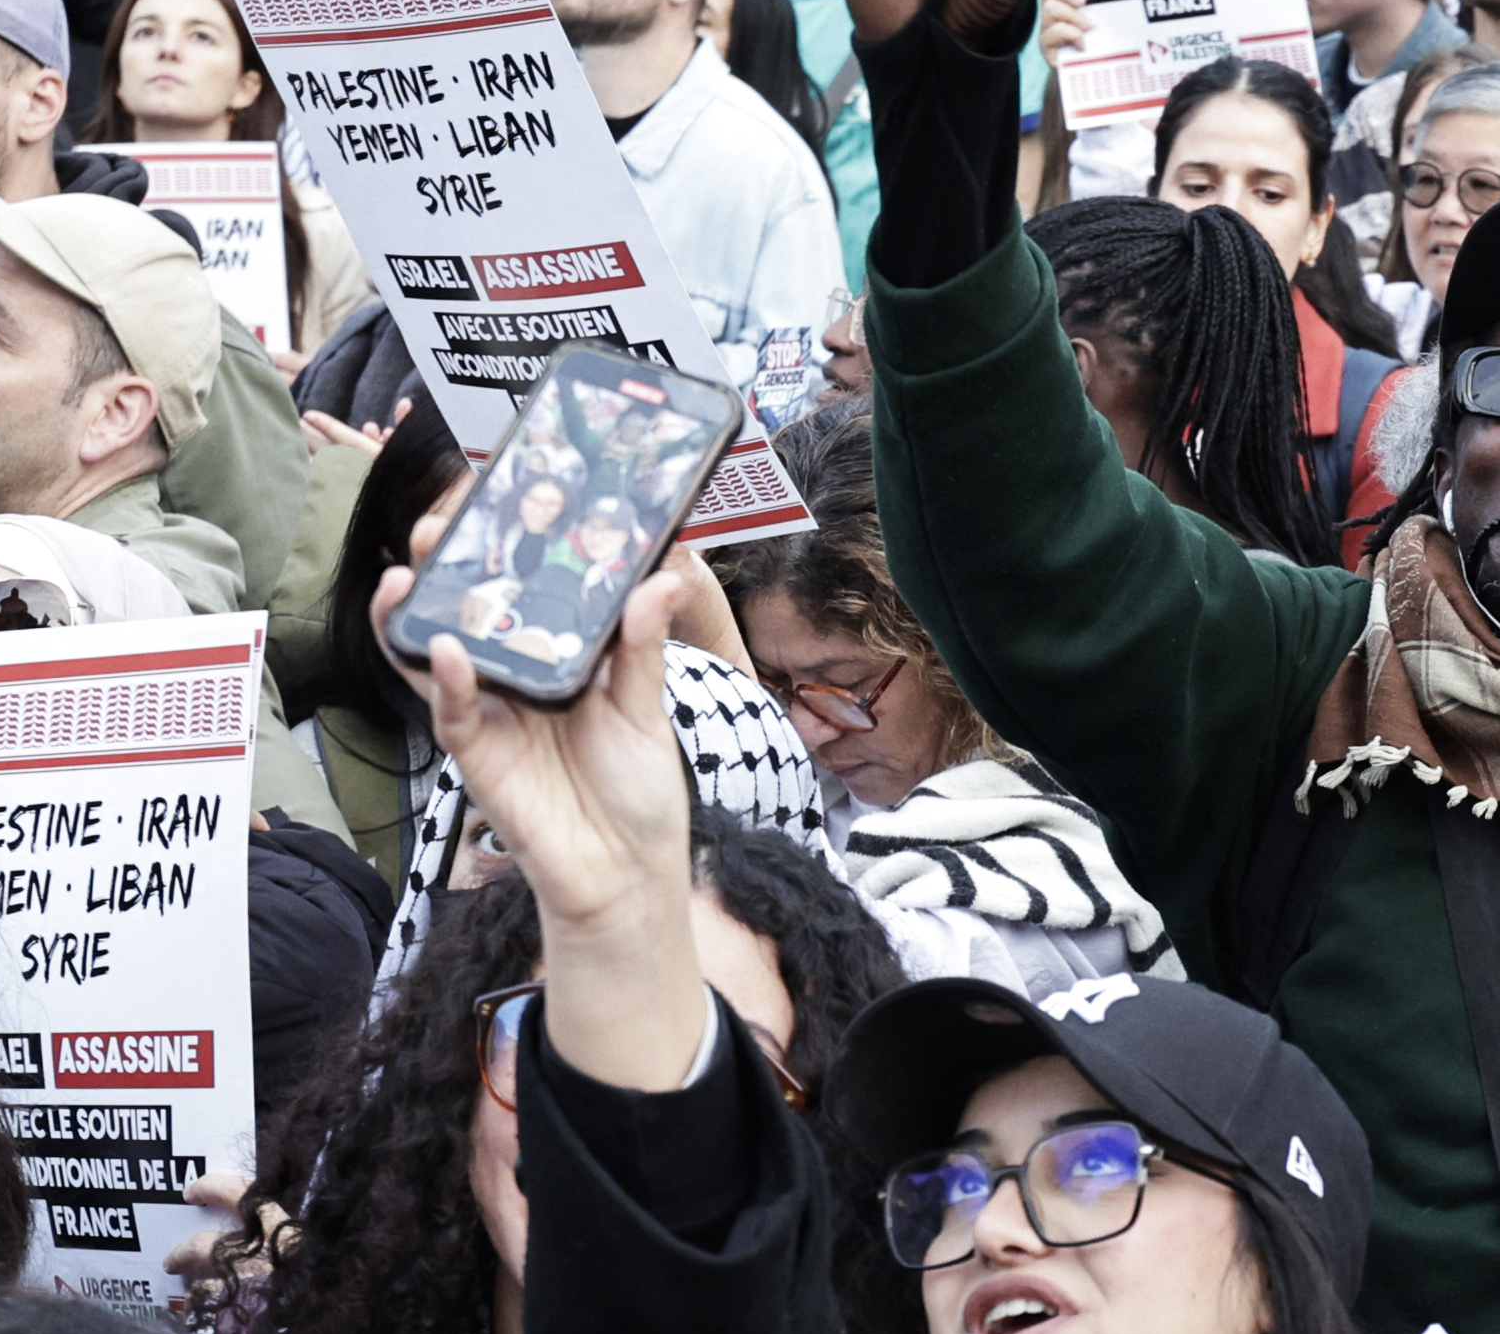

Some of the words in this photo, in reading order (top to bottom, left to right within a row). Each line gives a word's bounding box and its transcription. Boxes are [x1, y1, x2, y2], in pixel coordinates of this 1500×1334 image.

[1168, 31, 1224, 49] URGENCE
[286, 64, 445, 115] PALESTINE
[469, 51, 556, 102] IRAN
[326, 122, 424, 165] YEMEN
[447, 109, 557, 158] LIBAN
[416, 172, 503, 217] SYRIE
[206, 218, 264, 242] IRAN
[391, 257, 470, 289] ISRAEL
[480, 246, 626, 290] ASSASSINE
[441, 315, 489, 342] AVEC
[493, 318, 518, 342] LE
[520, 308, 618, 342] SOUTIEN
[436, 349, 549, 382] INCONDITION
[766, 341, 802, 369] STOP
[764, 370, 805, 387] GENOCIDE
[137, 793, 221, 850] IRAN
[86, 862, 196, 913] LIBAN
[20, 931, 111, 986] SYRIE
[58, 1034, 199, 1074] ASSASSINE
[47, 1108, 73, 1140] LE
[76, 1108, 168, 1142] SOUTIEN
[140, 1159, 168, 1190] DE
[172, 1160, 198, 1192] LA
[52, 1205, 133, 1240] FRANCE
[80, 1277, 154, 1303] URGENCE
